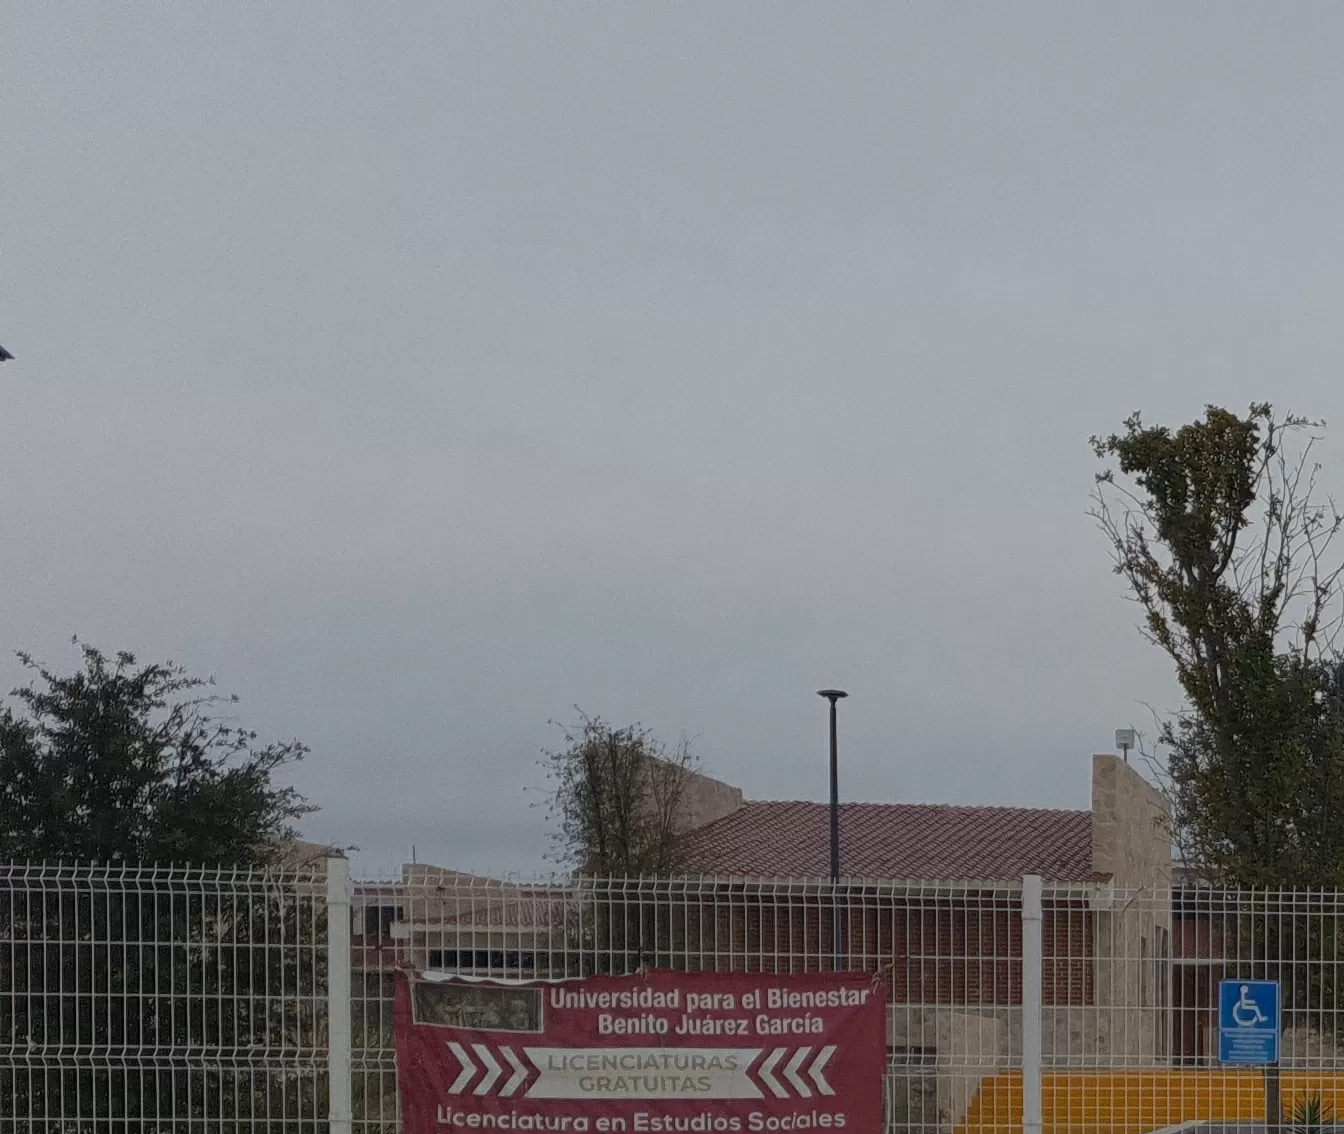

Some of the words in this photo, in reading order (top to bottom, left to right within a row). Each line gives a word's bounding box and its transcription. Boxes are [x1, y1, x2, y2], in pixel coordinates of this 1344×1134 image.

[550, 987, 679, 1008] Universidad
[686, 993, 735, 1011] para
[742, 988, 760, 1008] el
[768, 987, 869, 1008] Bienestar
[599, 1014, 668, 1035] Benito
[675, 1013, 748, 1036] Juárez
[756, 1013, 823, 1035] García
[548, 1054, 738, 1072] LICENCIATURAS
[579, 1075, 712, 1093] GRATUITAS
[437, 1105, 588, 1132] Licenciatura
[596, 1116, 626, 1131] en
[634, 1113, 740, 1131] Estudios
[748, 1110, 846, 1131] Sociales
